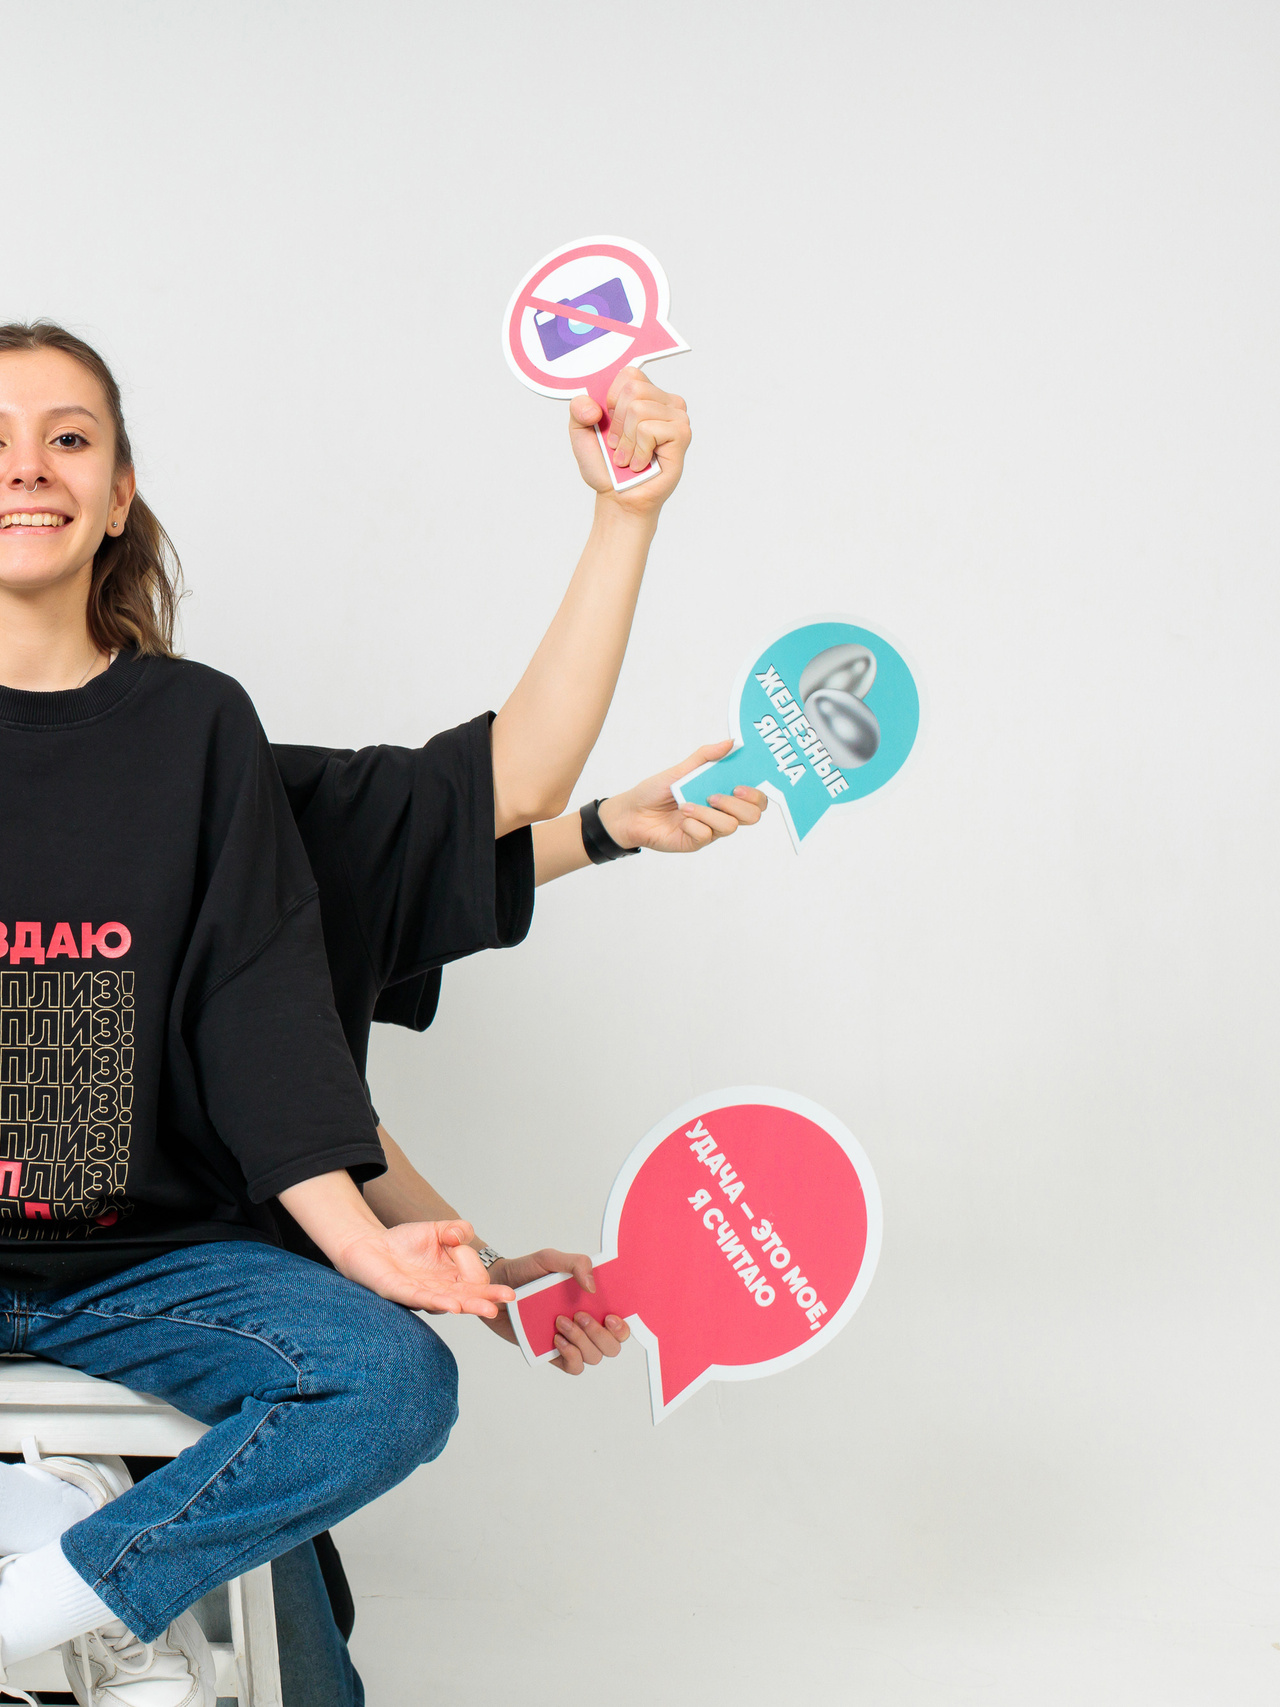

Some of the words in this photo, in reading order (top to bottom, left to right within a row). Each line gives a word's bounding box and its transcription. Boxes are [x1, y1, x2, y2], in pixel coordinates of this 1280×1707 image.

[753, 714, 807, 786] ЯЙЦА
[754, 663, 850, 799] ЖЕЛЕЗНЫЕ
[685, 1119, 745, 1204] УДАЧА
[751, 1218, 791, 1269] ЭТО
[782, 1266, 827, 1331] МОЕ,
[687, 1188, 712, 1211] Я
[703, 1207, 776, 1307] СЧИТАЮ
